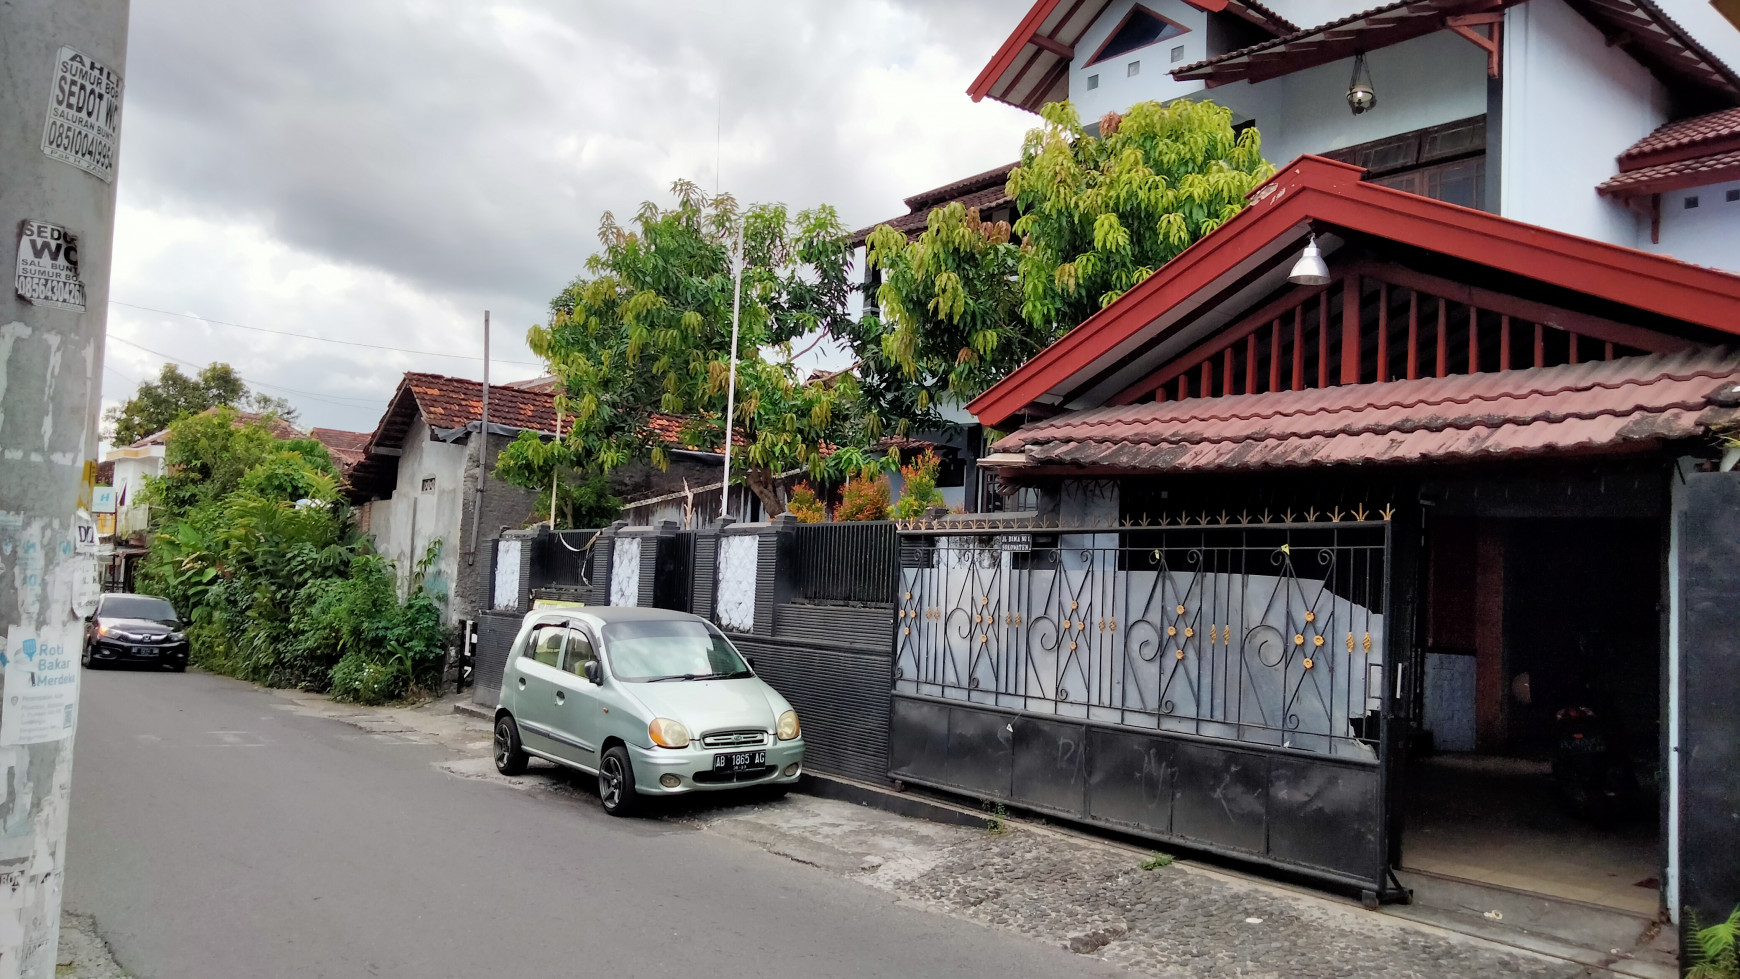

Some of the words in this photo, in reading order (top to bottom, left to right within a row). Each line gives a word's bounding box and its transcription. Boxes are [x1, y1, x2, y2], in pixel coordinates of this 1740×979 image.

[60, 60, 102, 90] SUMUR
[68, 53, 119, 89] AHLI
[56, 74, 104, 122] SEDOT
[105, 97, 118, 134] WC
[53, 107, 95, 132] SALURAN
[29, 238, 78, 267] WC
[21, 267, 62, 280] SUMUR
[39, 643, 64, 656] Roti
[38, 659, 71, 672] Bakar
[715, 755, 725, 768] AB
[732, 753, 750, 766] 1865
[754, 752, 765, 764] AG
